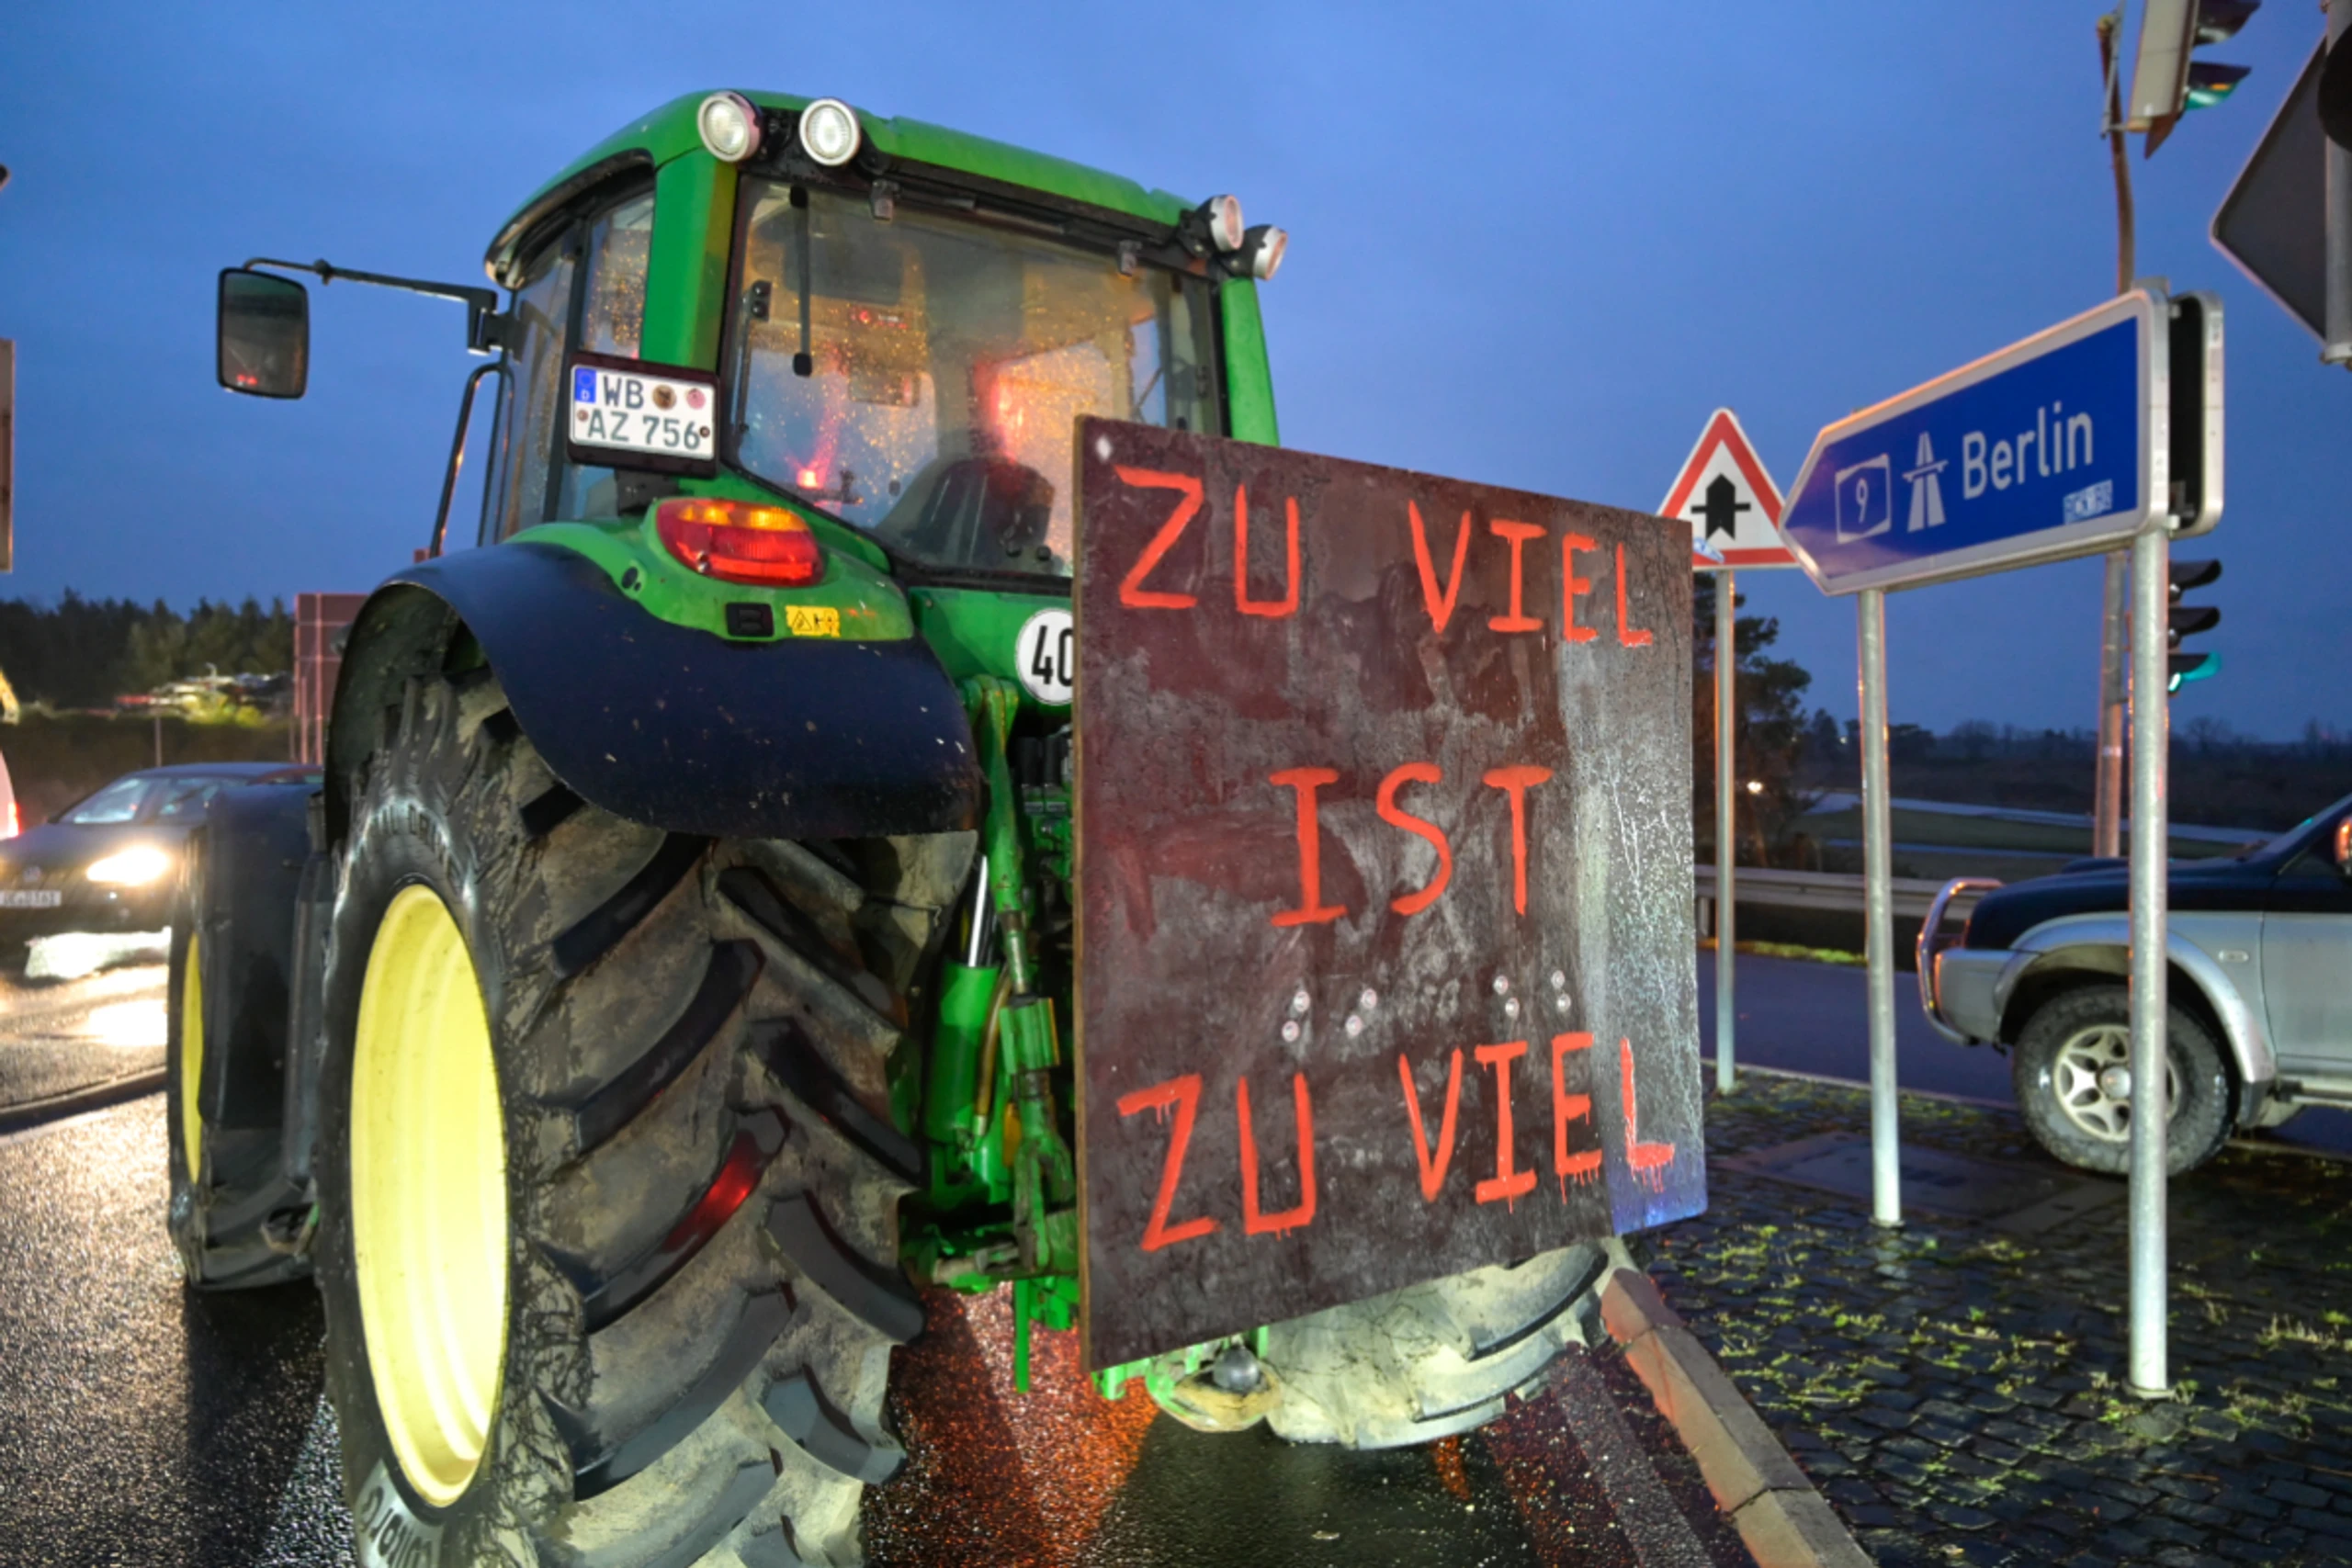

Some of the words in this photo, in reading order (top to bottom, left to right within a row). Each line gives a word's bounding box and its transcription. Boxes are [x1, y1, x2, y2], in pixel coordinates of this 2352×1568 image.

[587, 409, 629, 443] AZ
[642, 414, 701, 451] 756
[603, 375, 644, 410] WB
[1854, 478, 1870, 525] 9
[1962, 400, 2093, 500] Berlin
[1114, 465, 1301, 618] ZU
[1408, 500, 1654, 648] VIEL
[1031, 625, 1073, 687] 40
[1270, 761, 1555, 928] IST
[1116, 1073, 1317, 1253] ZU
[1398, 1032, 1676, 1213] VIEL
